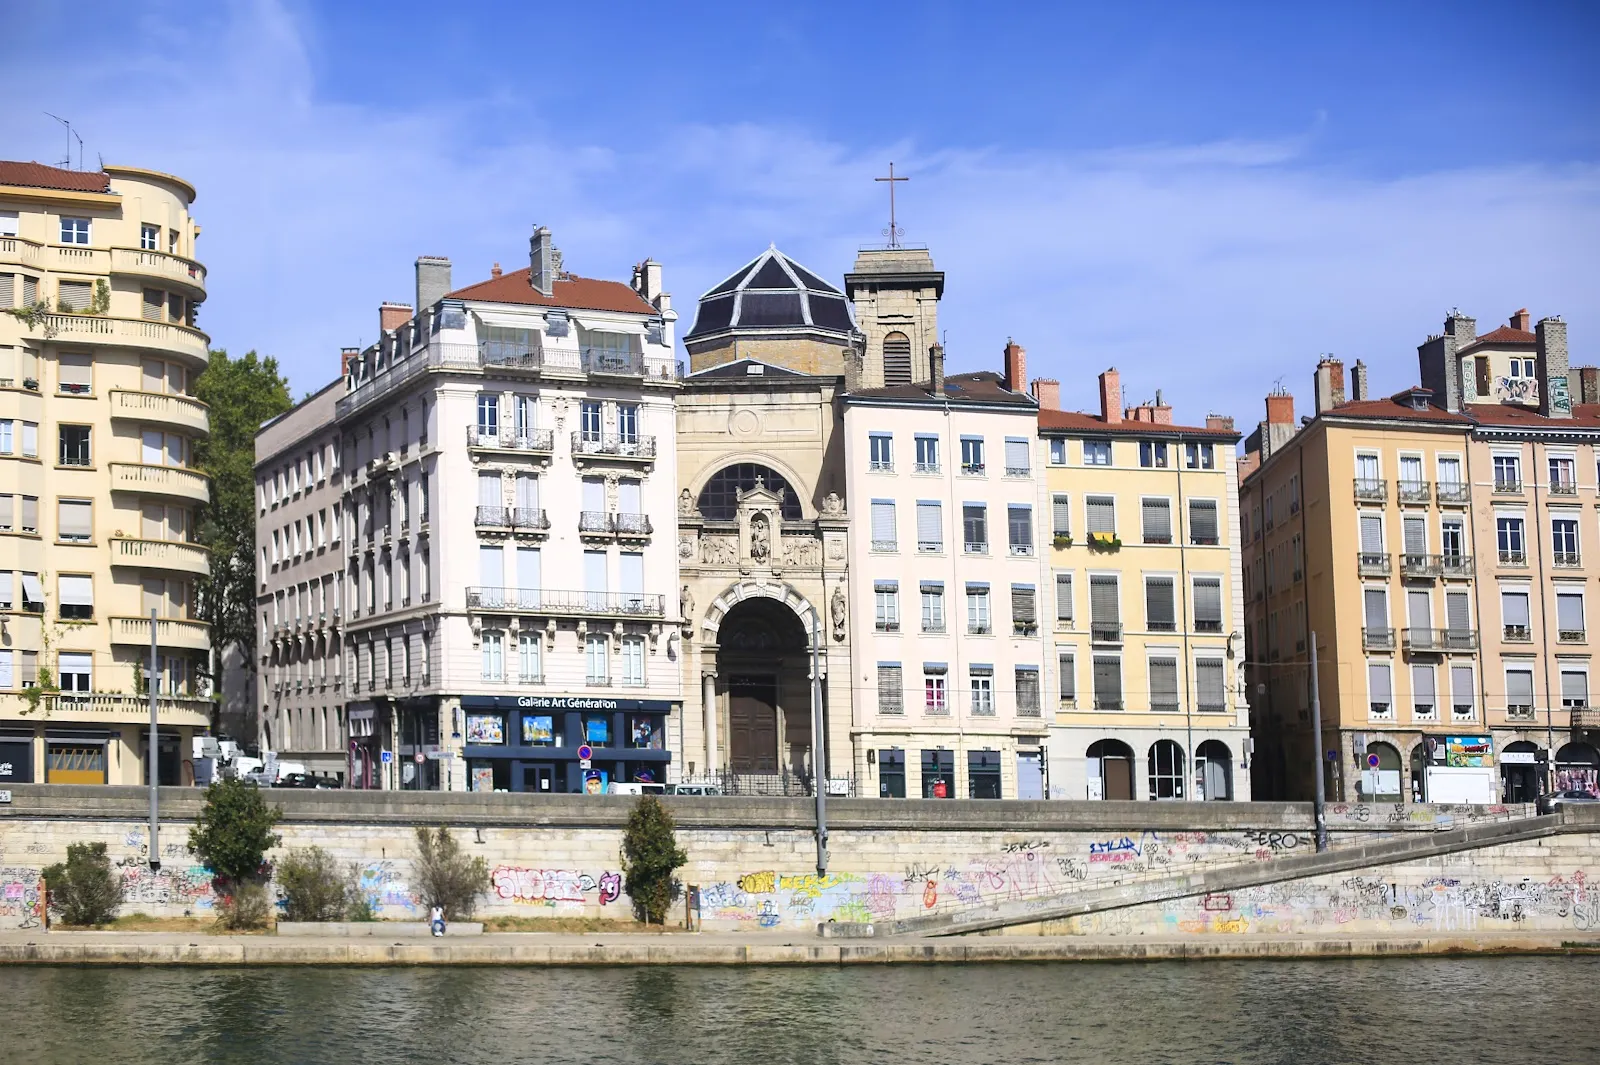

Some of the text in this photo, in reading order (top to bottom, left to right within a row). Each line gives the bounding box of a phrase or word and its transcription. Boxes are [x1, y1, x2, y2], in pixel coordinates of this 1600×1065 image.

[517, 696, 617, 709] Galerie Art Génération
